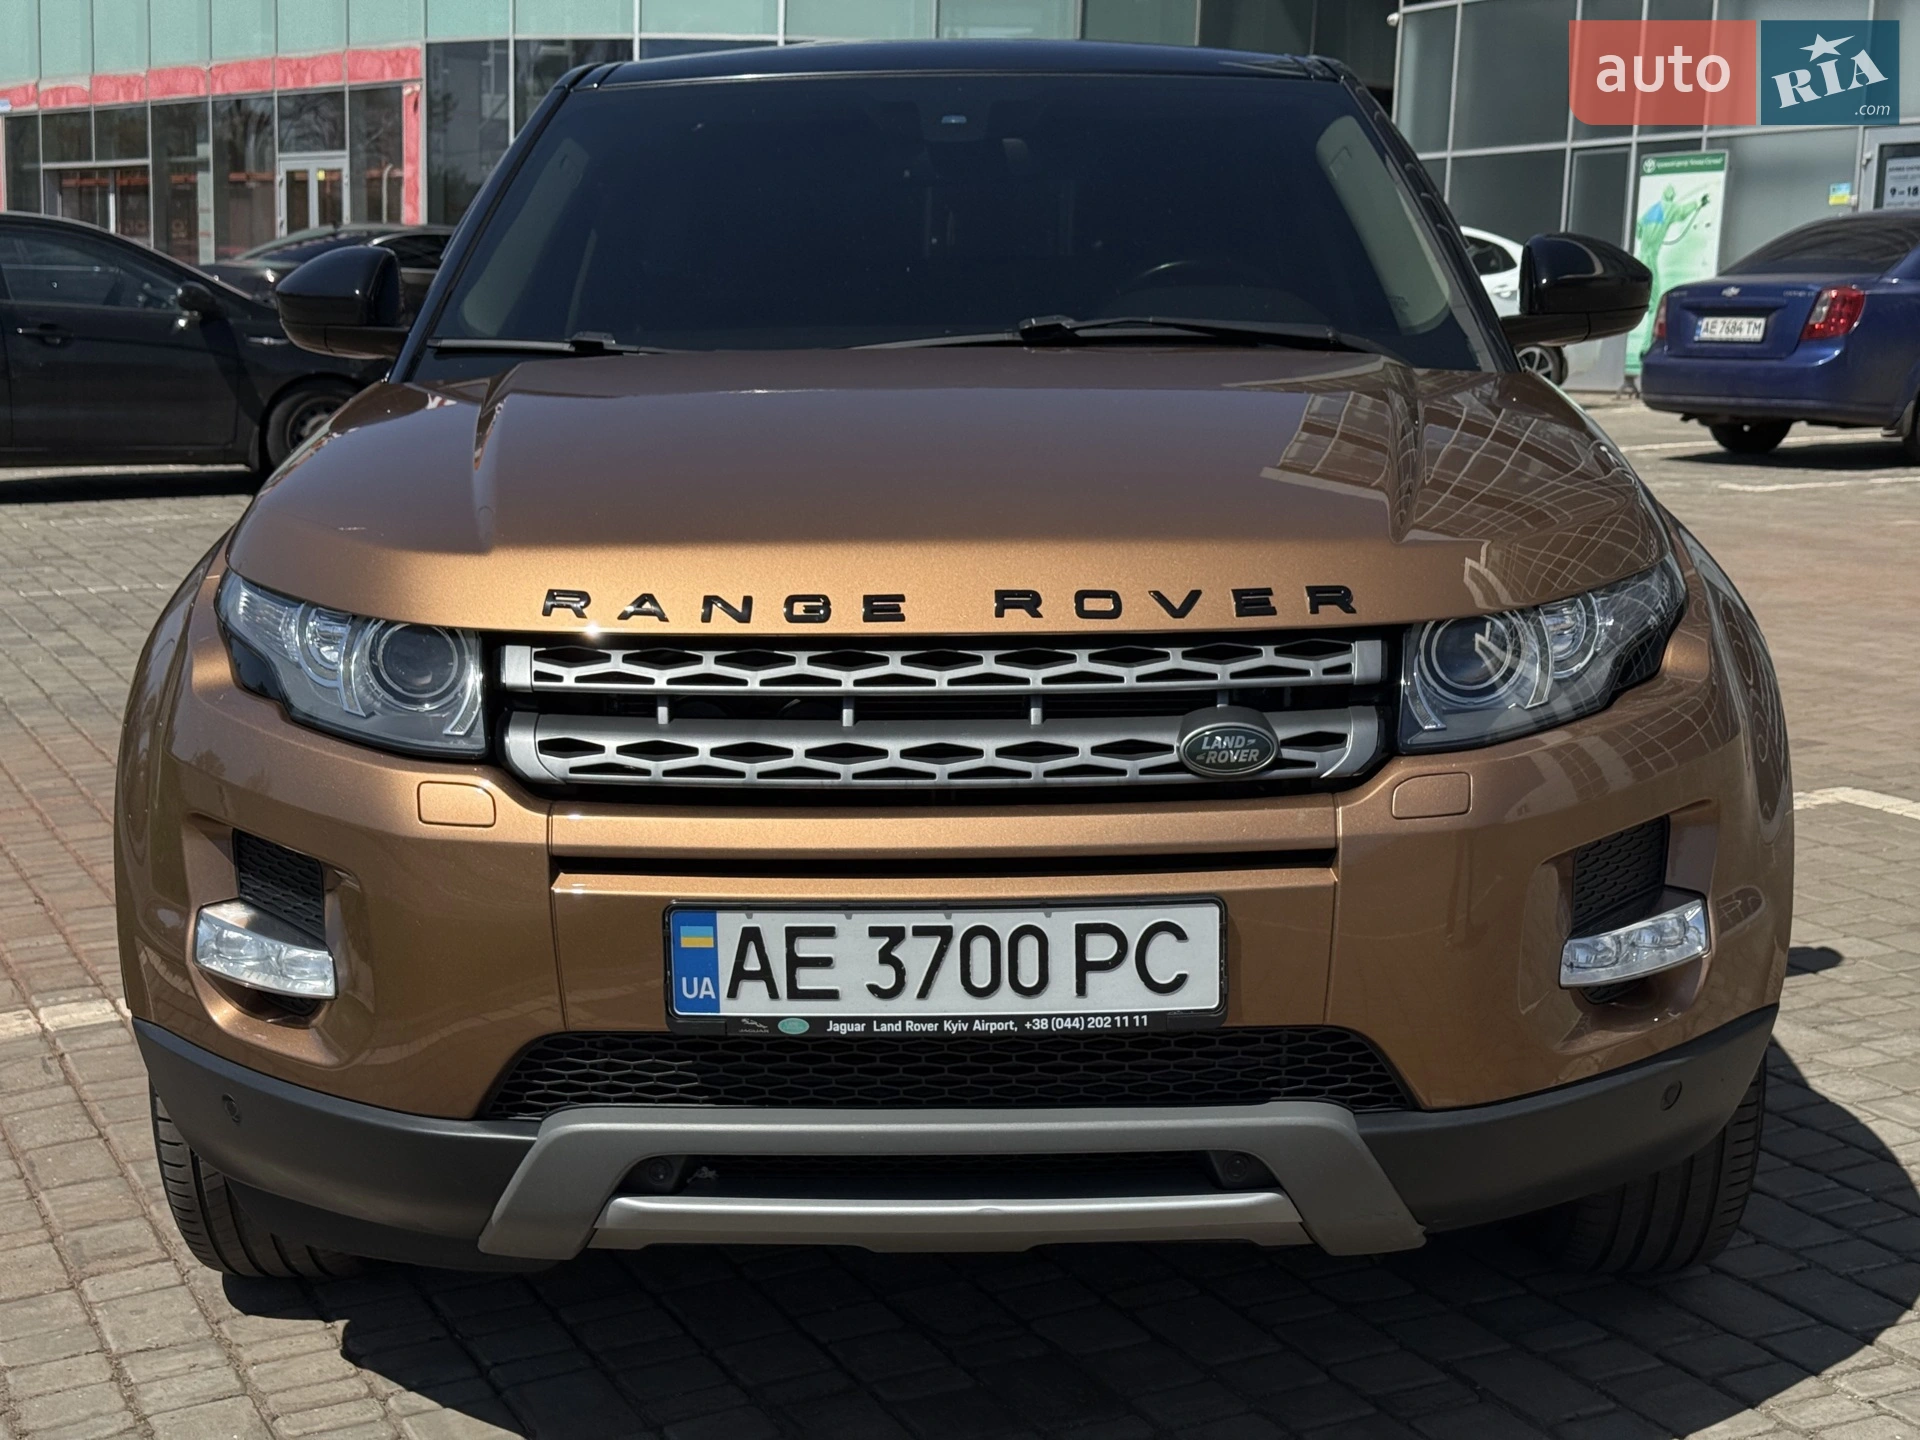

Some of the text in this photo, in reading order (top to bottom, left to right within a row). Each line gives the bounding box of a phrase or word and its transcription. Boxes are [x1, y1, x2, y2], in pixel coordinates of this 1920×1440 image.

[1702, 320, 1717, 334] AE
[1746, 320, 1762, 335] TM
[541, 584, 1357, 625] RANGE ROVER
[1201, 735, 1246, 750] LAND
[1205, 748, 1260, 764] ROVER
[726, 921, 1190, 1001] AE 3700 PC
[681, 976, 716, 1000] UA
[826, 1014, 1149, 1034] Jaguar Land Rover Kyiv Airport, +38 (044) 202 11 11
